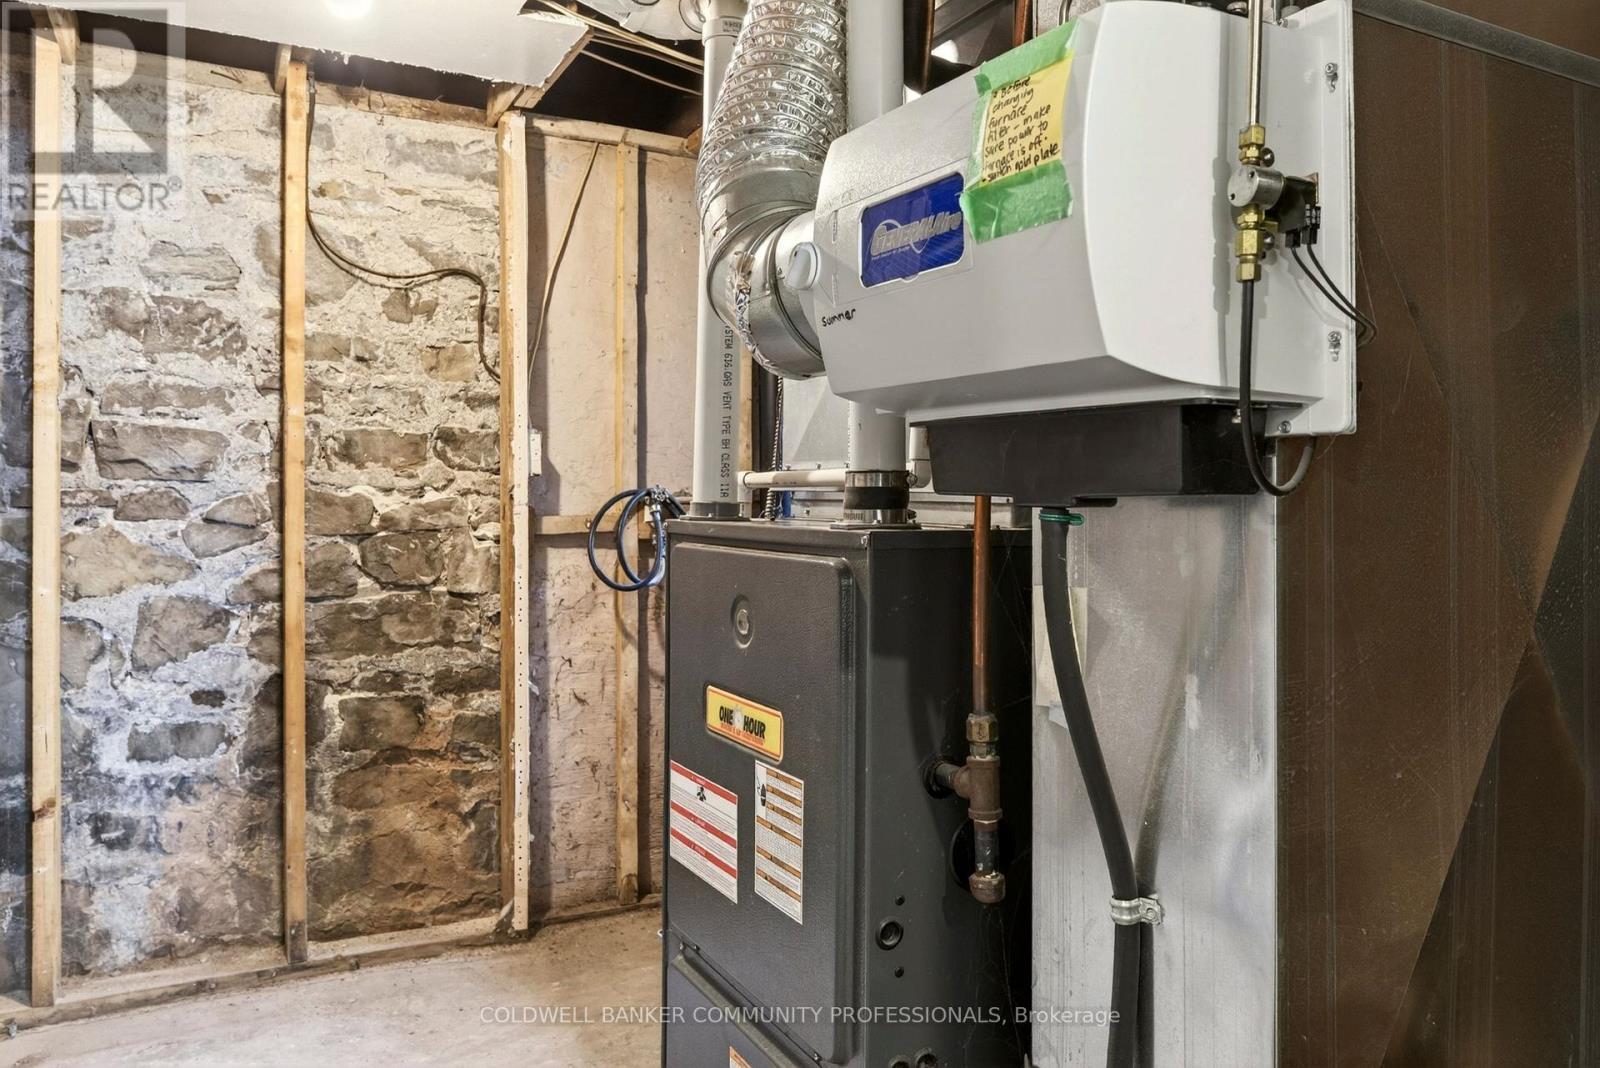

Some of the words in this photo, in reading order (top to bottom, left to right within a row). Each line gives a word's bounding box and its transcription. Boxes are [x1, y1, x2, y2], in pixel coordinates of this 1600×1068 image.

[992, 88, 1034, 114] changing
[989, 104, 1027, 128] furnace
[1023, 104, 1051, 126] make
[985, 140, 1005, 158] sure
[1008, 125, 1035, 149] power
[1037, 120, 1048, 132] to
[1017, 143, 1026, 157] is
[722, 391, 732, 410] VENT
[721, 416, 731, 435] TYPE
[720, 453, 730, 478] CLASS
[719, 705, 733, 726] ONE
[743, 714, 766, 739] HOUR
